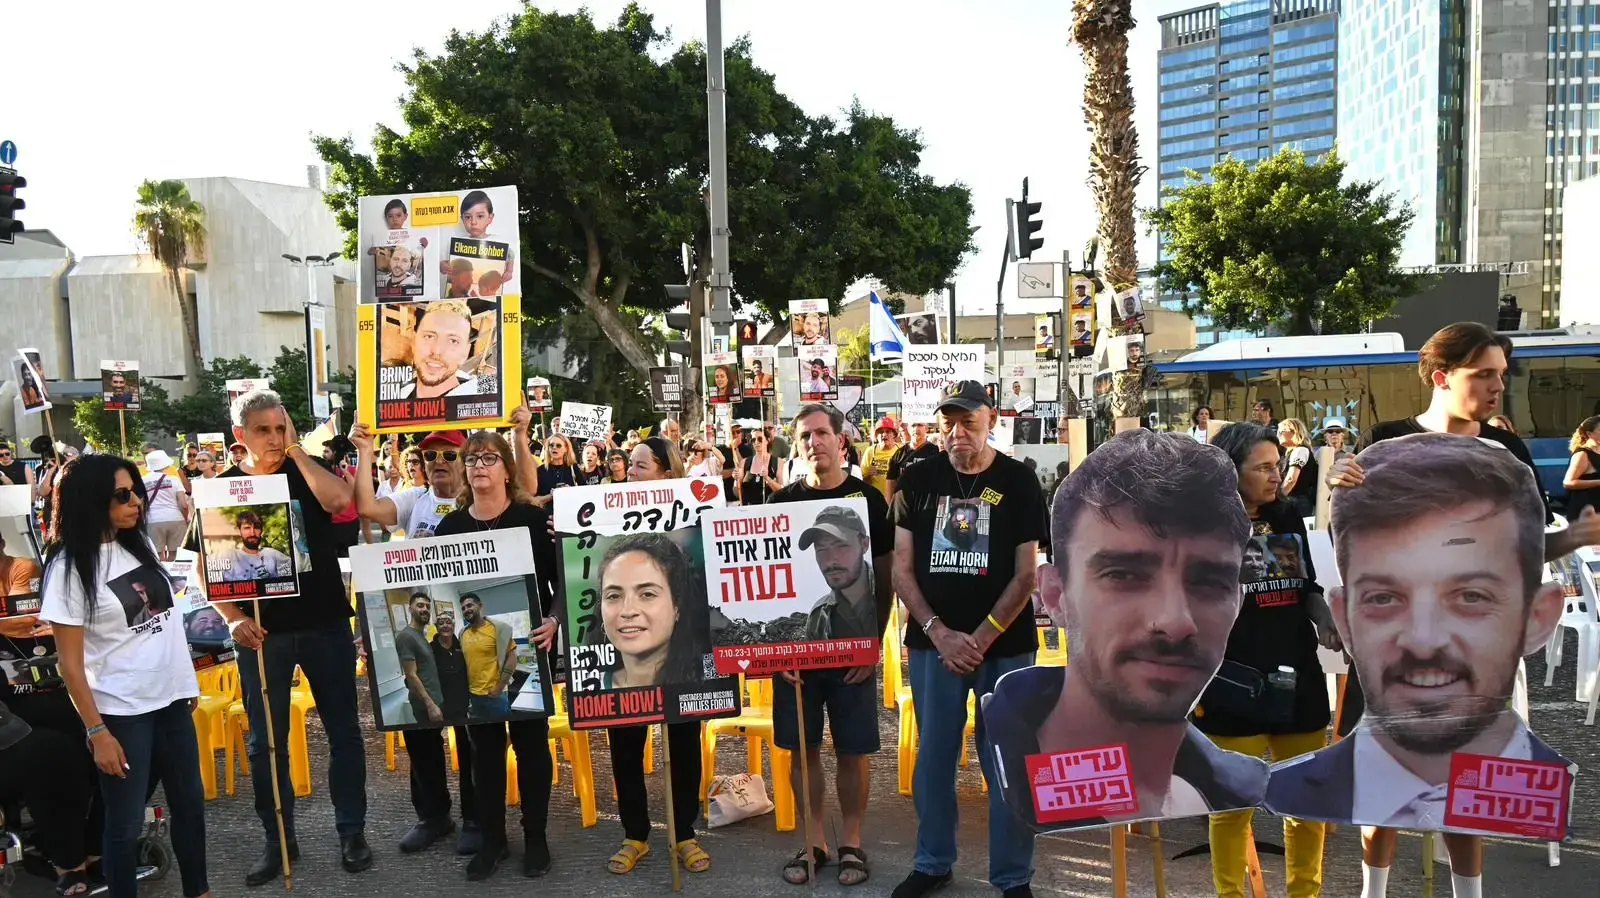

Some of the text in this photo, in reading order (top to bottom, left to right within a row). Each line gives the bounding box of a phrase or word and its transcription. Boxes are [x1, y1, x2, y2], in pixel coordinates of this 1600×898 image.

[416, 208, 428, 216] בעזה
[429, 206, 442, 216] חטוף
[454, 242, 504, 257] Elkana Bohbot
[504, 312, 518, 324] 695
[360, 320, 374, 330] 695
[908, 352, 977, 362] חמאס מסכים
[380, 366, 412, 383] BRING
[922, 362, 956, 378] לעסקה.
[380, 383, 400, 400] HIM
[380, 399, 446, 419] HOME NOW!
[457, 407, 497, 417] FAMILIES FORUM
[230, 488, 240, 496] GUY
[982, 488, 1000, 503] 695
[604, 489, 674, 509] ענבר הימן (27)
[713, 514, 790, 538] לא שוכחים
[383, 540, 496, 564] גלי וזיו ברמן (27), חטופים.
[716, 536, 792, 564] את איתי
[207, 559, 231, 571] BRING
[930, 551, 988, 568] EITAN HORN
[384, 556, 499, 584] תמונת הניצחון המוחלט
[208, 571, 224, 583] HIM
[720, 563, 796, 603] בעזה
[209, 582, 256, 595] HOME NOW!
[1268, 580, 1280, 590] דוד
[152, 626, 162, 634] 25
[752, 647, 774, 658] ונחטף
[776, 646, 792, 655] בקרב
[795, 644, 806, 653] נפל
[826, 642, 834, 652] חן
[836, 642, 851, 650] איתי
[13, 684, 33, 695] ריאל
[679, 690, 733, 702] HOSTAGES AND MISSING
[573, 686, 664, 718] HOME NOW!
[680, 698, 734, 712] FAMILIES FORUM
[1056, 750, 1122, 779] עדיין
[1485, 764, 1560, 791] עדיין
[1049, 780, 1129, 807] בעזה.
[1462, 794, 1555, 823] בעזה.
